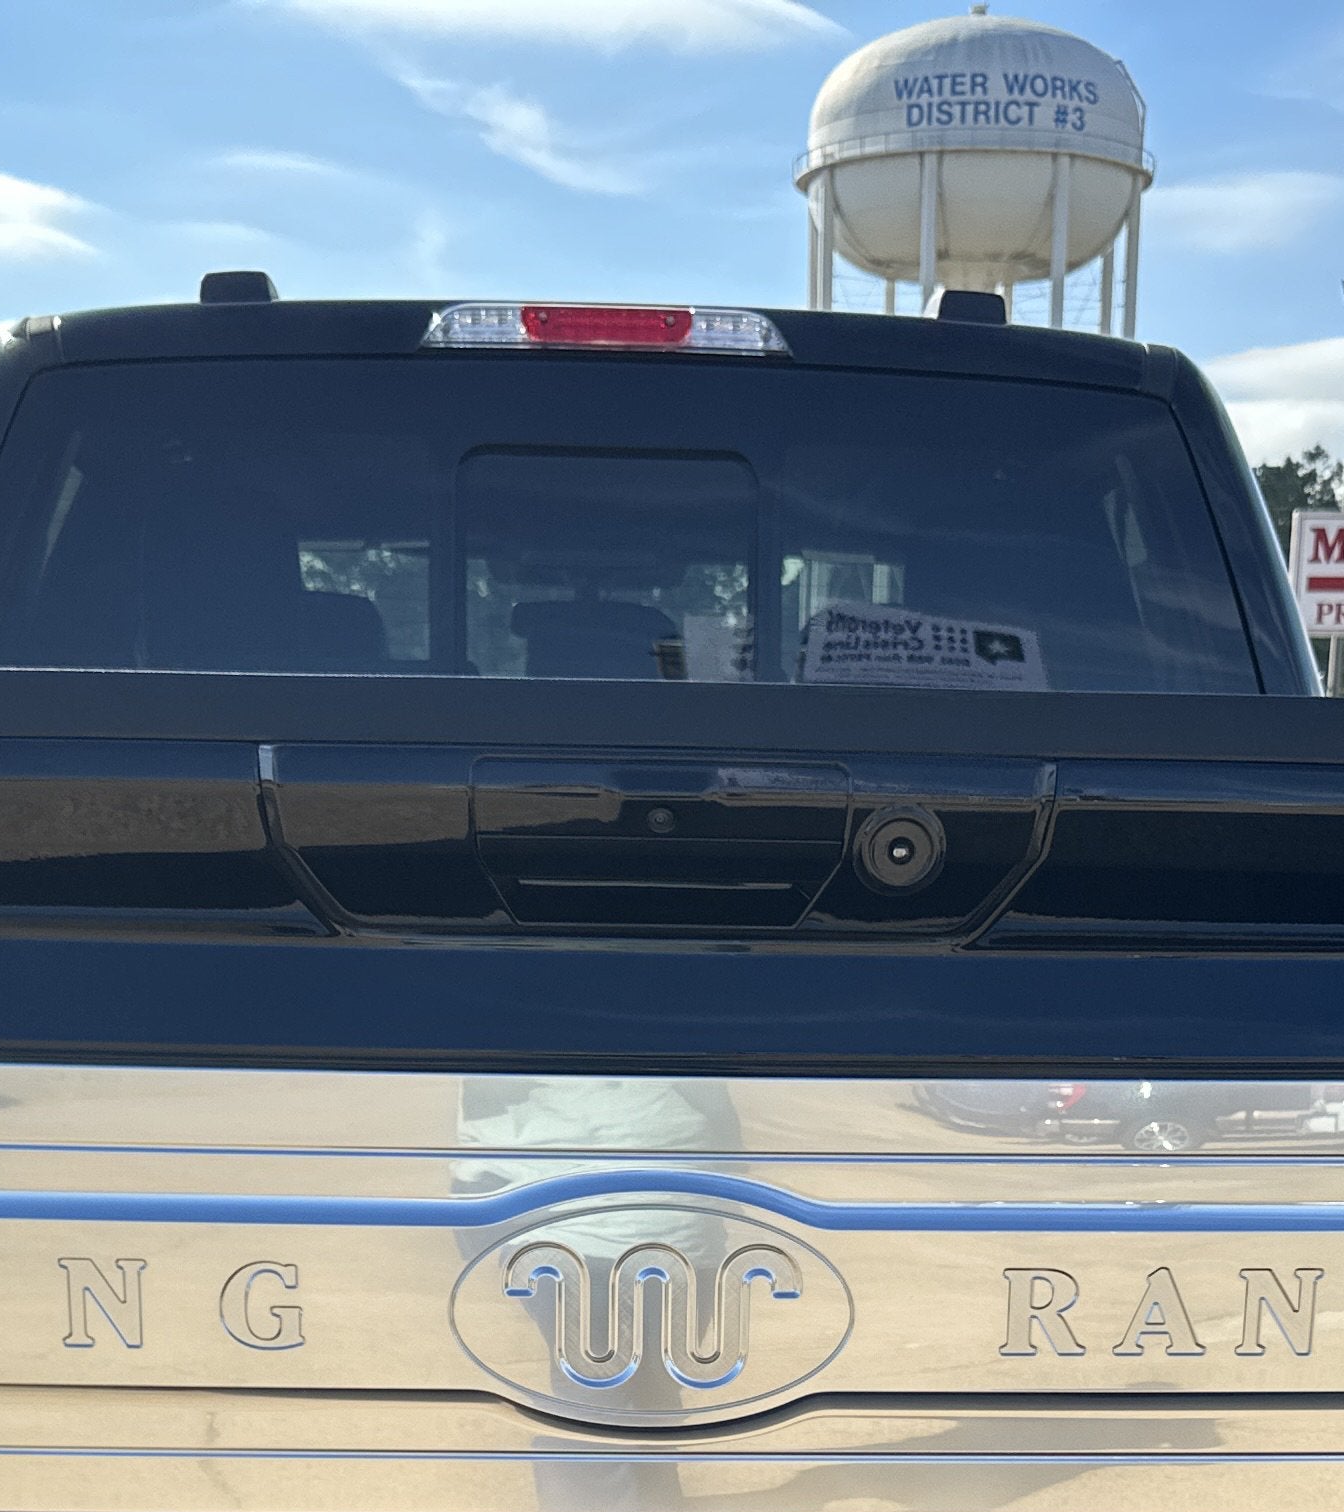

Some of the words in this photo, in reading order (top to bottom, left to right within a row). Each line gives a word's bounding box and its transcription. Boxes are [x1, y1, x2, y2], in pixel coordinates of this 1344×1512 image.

[894, 73, 988, 101] WATER
[1002, 73, 1099, 105] WORKS
[906, 101, 1040, 128] DISTRICT
[1053, 105, 1087, 131] #3
